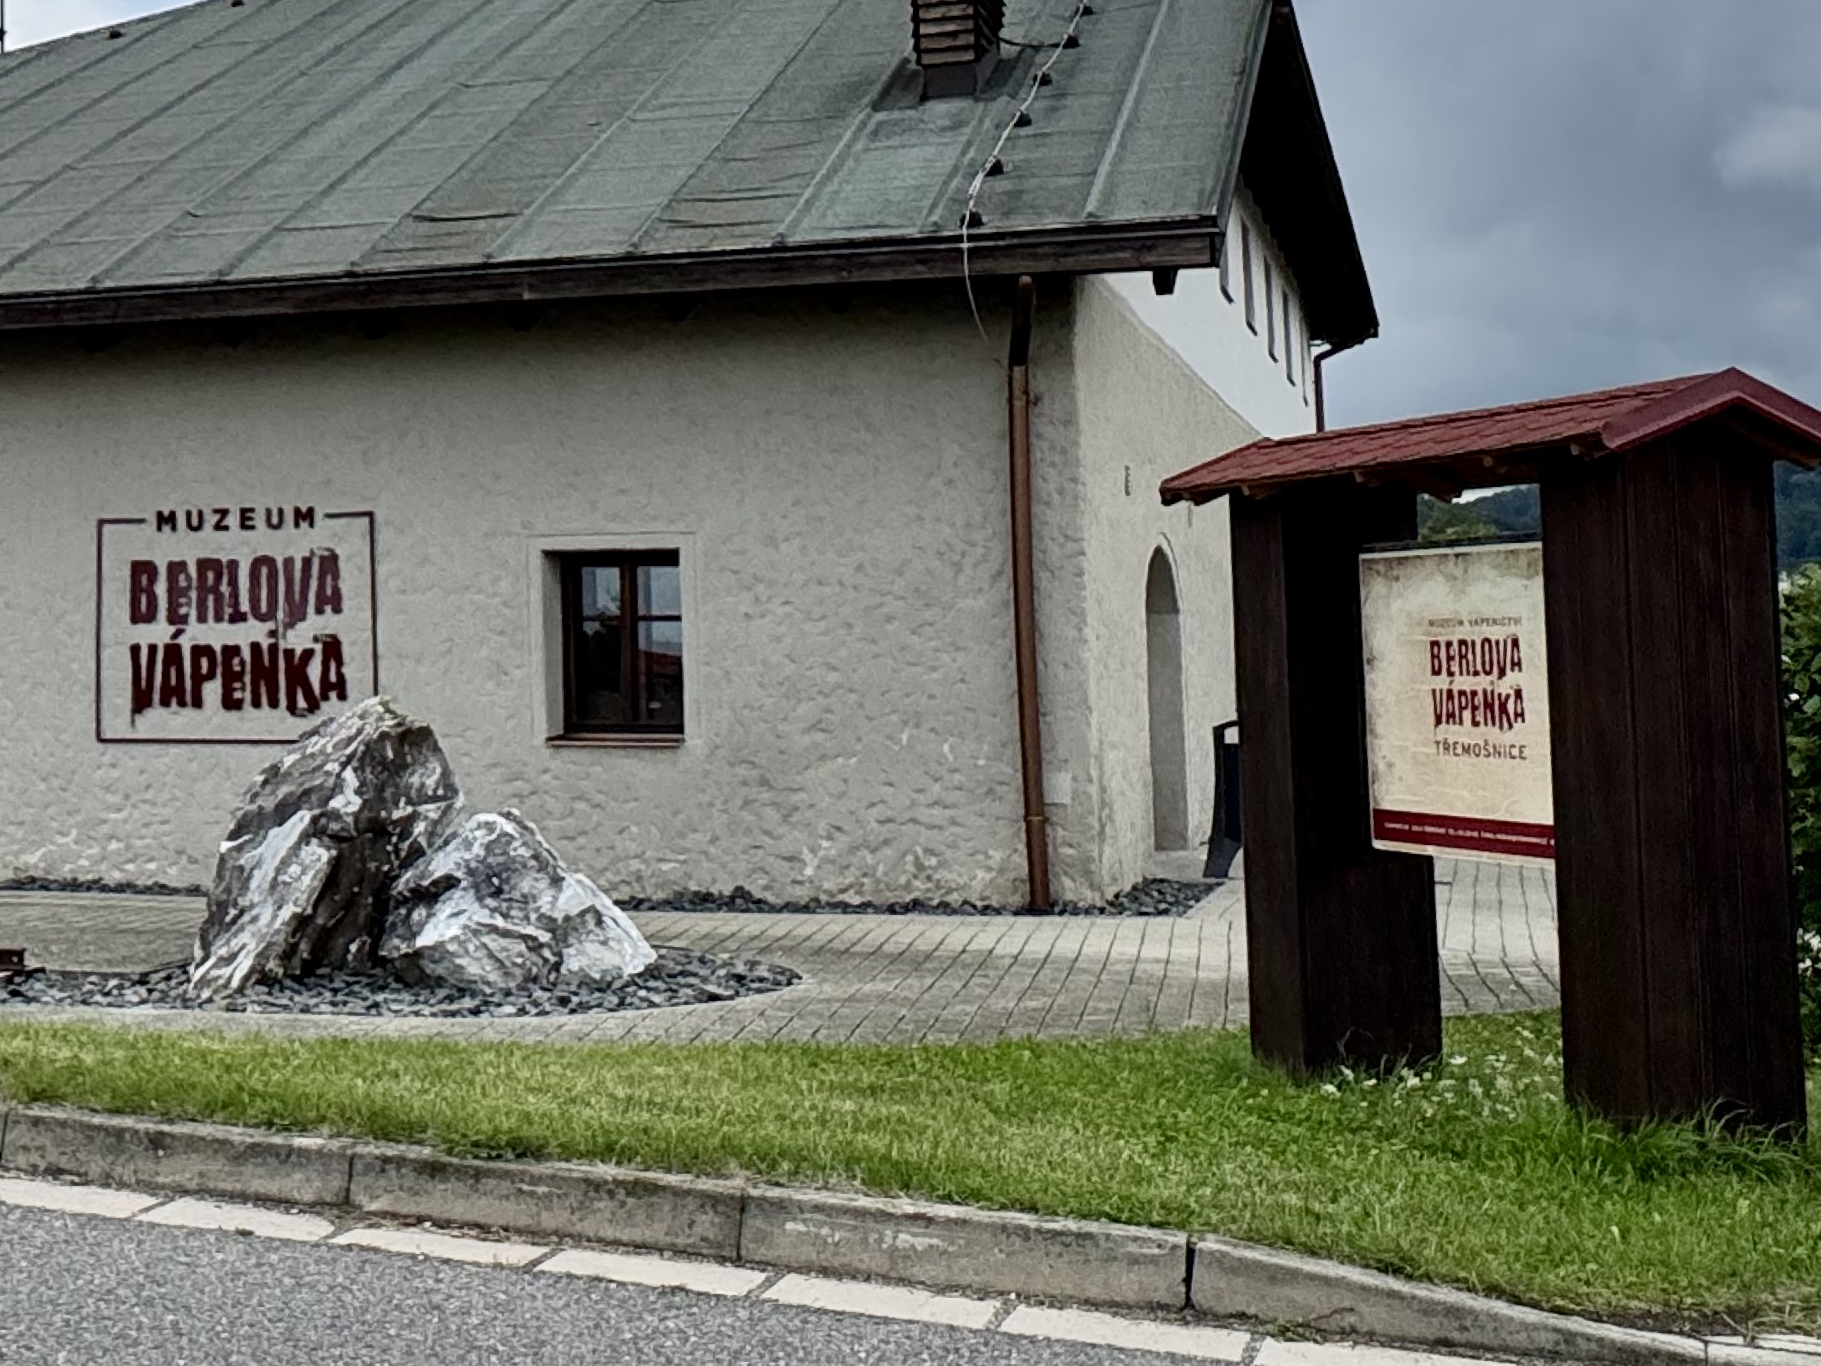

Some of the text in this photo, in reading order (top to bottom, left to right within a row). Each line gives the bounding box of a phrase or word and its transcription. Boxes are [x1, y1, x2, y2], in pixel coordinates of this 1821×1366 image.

[156, 505, 315, 532] MUZEUM
[130, 548, 343, 629] BERLOVA
[129, 628, 347, 720] VÁPENKA
[1429, 634, 1522, 680] BERLOVA
[1431, 680, 1525, 733] VÁPENKA
[1434, 737, 1528, 760] TŘEMOŠNICE
